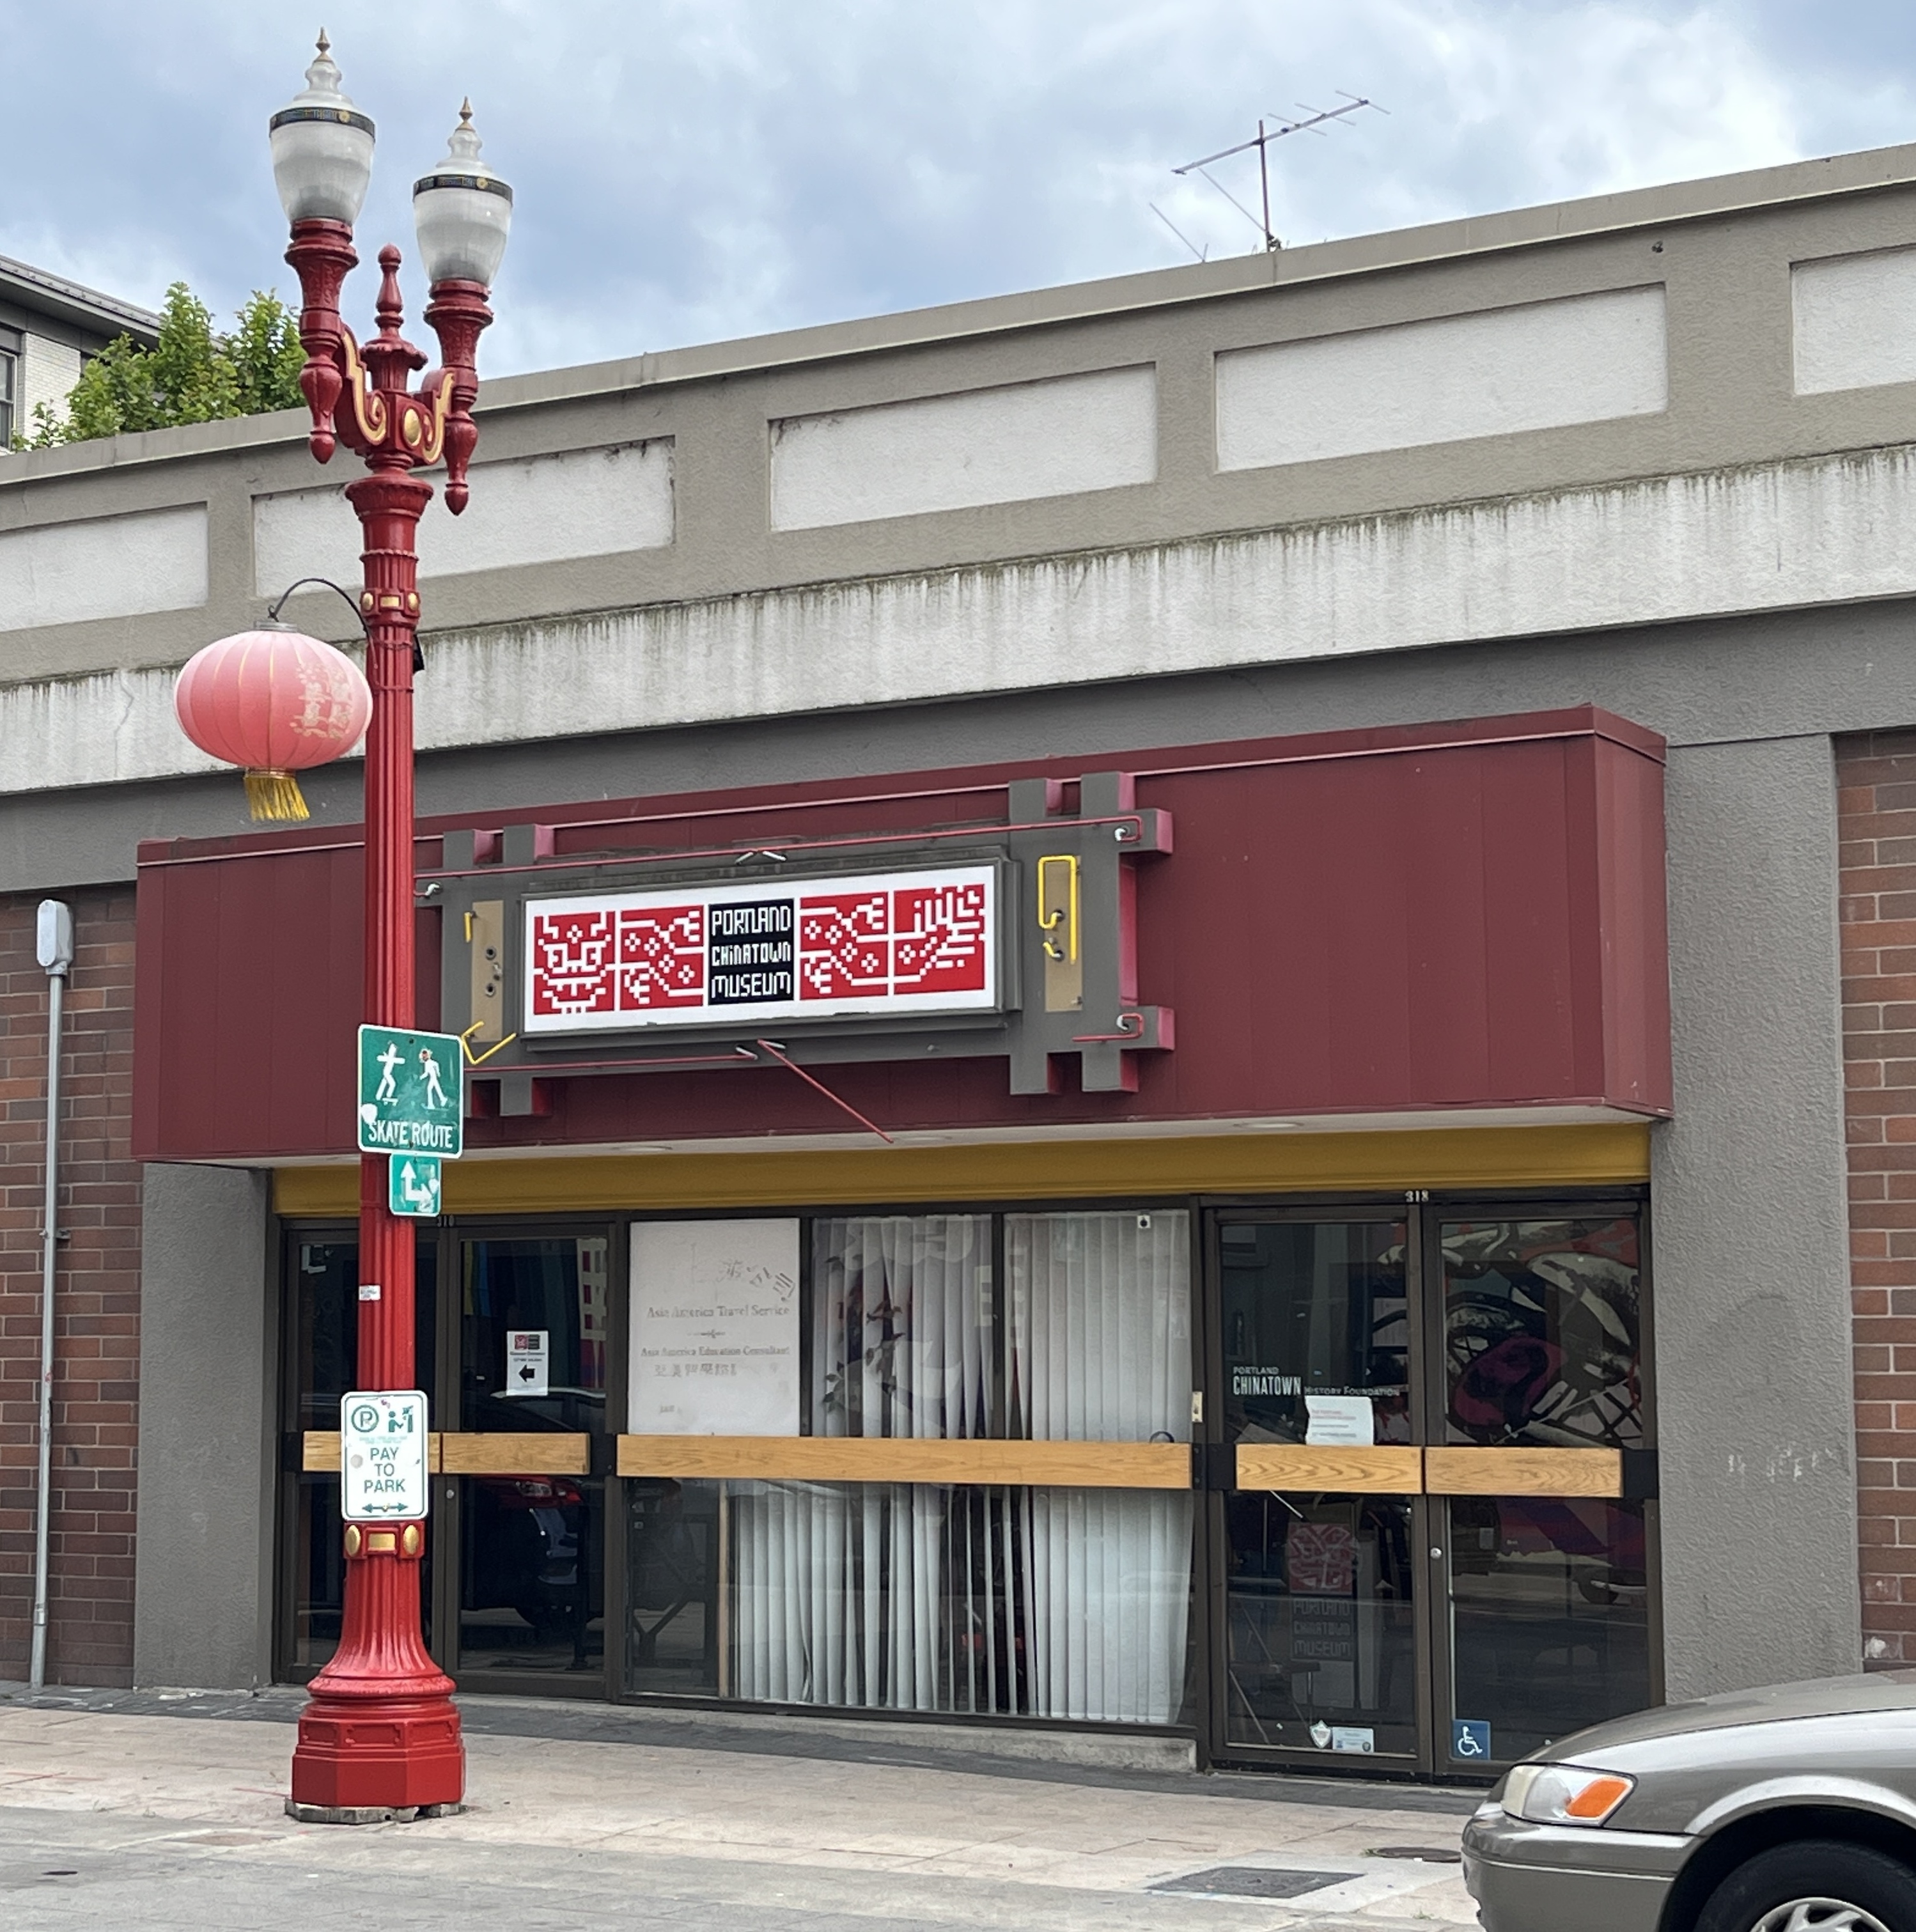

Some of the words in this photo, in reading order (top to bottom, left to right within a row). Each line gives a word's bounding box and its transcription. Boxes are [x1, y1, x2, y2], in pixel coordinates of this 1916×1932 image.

[712, 906, 791, 936] PORTLAND
[712, 972, 791, 998] MUSEUM
[368, 1120, 409, 1145] SKATE
[412, 1122, 453, 1148] ROUTE
[1405, 1190, 1429, 1203] 318
[1233, 1366, 1279, 1375] PORTLAND
[1233, 1376, 1302, 1395] CHINATOWN
[370, 1447, 399, 1461] PAY
[374, 1463, 395, 1477] TO
[364, 1479, 406, 1493] PARK
